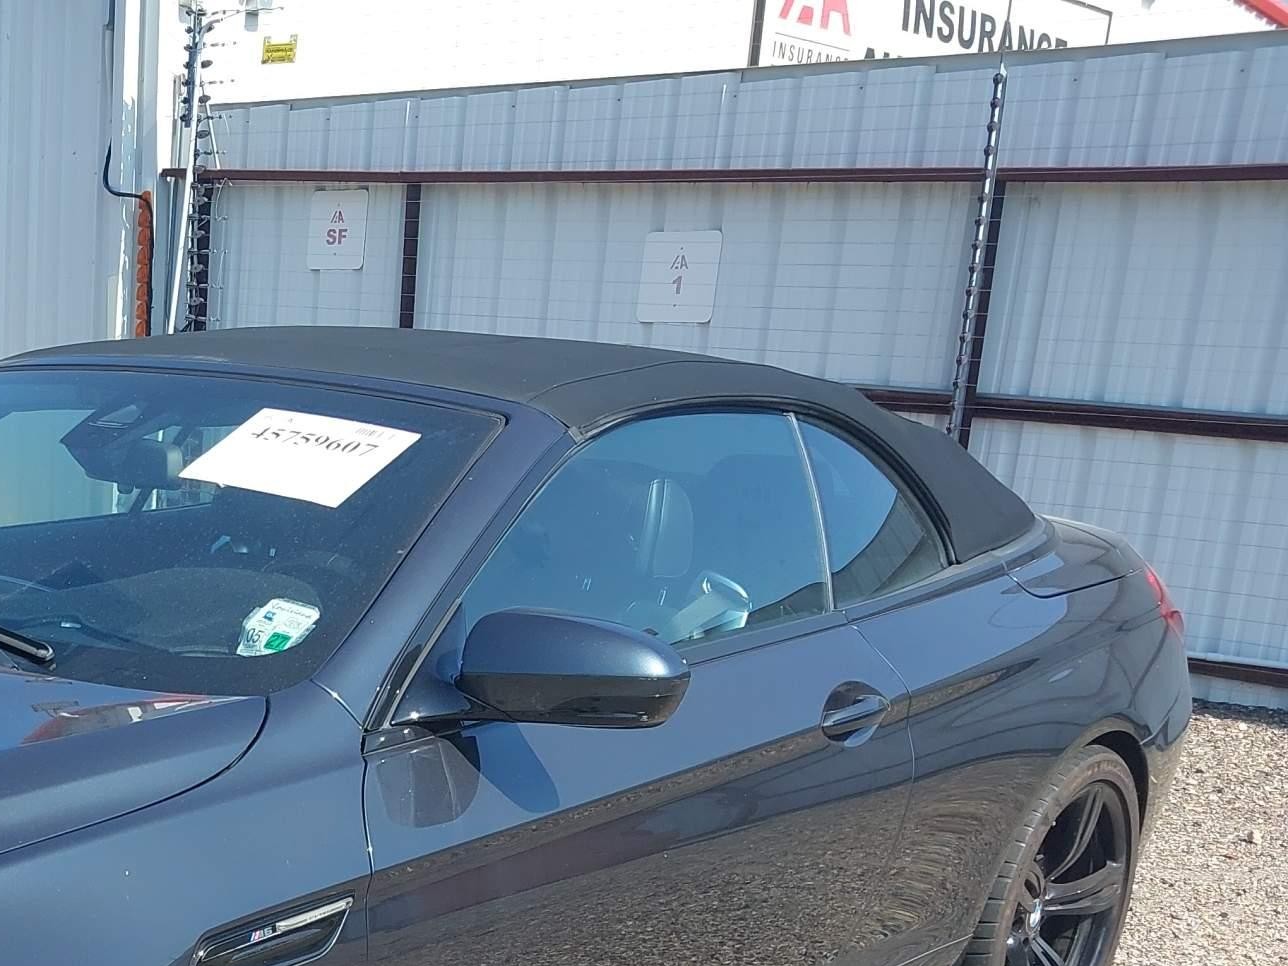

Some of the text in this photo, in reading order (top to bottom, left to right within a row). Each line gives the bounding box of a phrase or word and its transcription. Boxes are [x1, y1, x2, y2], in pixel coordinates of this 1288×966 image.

[901, 0, 1068, 52] INSURAN
[772, 41, 849, 64] INSURAN
[326, 228, 348, 246] SF
[672, 276, 682, 295] 1
[249, 426, 379, 456] 45759607
[246, 628, 265, 644] 05
[268, 632, 290, 651] 27
